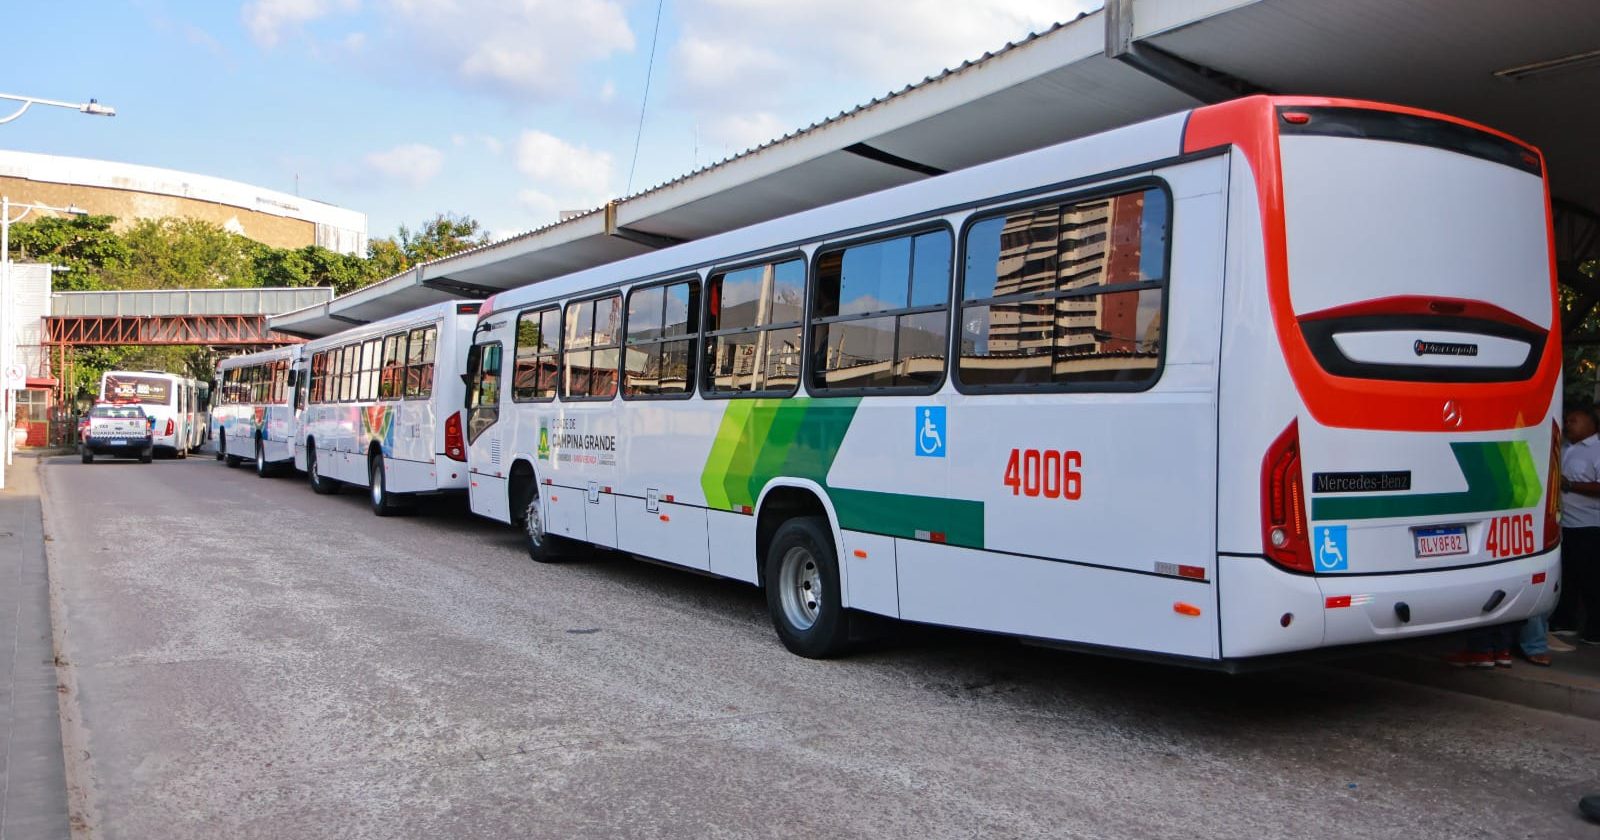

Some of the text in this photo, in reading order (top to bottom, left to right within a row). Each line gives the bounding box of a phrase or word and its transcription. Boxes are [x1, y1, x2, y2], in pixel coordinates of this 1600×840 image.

[552, 433, 616, 451] CAMPINA GRANDE
[1003, 448, 1082, 501] 4006
[1317, 472, 1408, 490] Mercedes-Benz
[1420, 536, 1462, 553] RLY8F82
[1486, 514, 1534, 558] 4006
